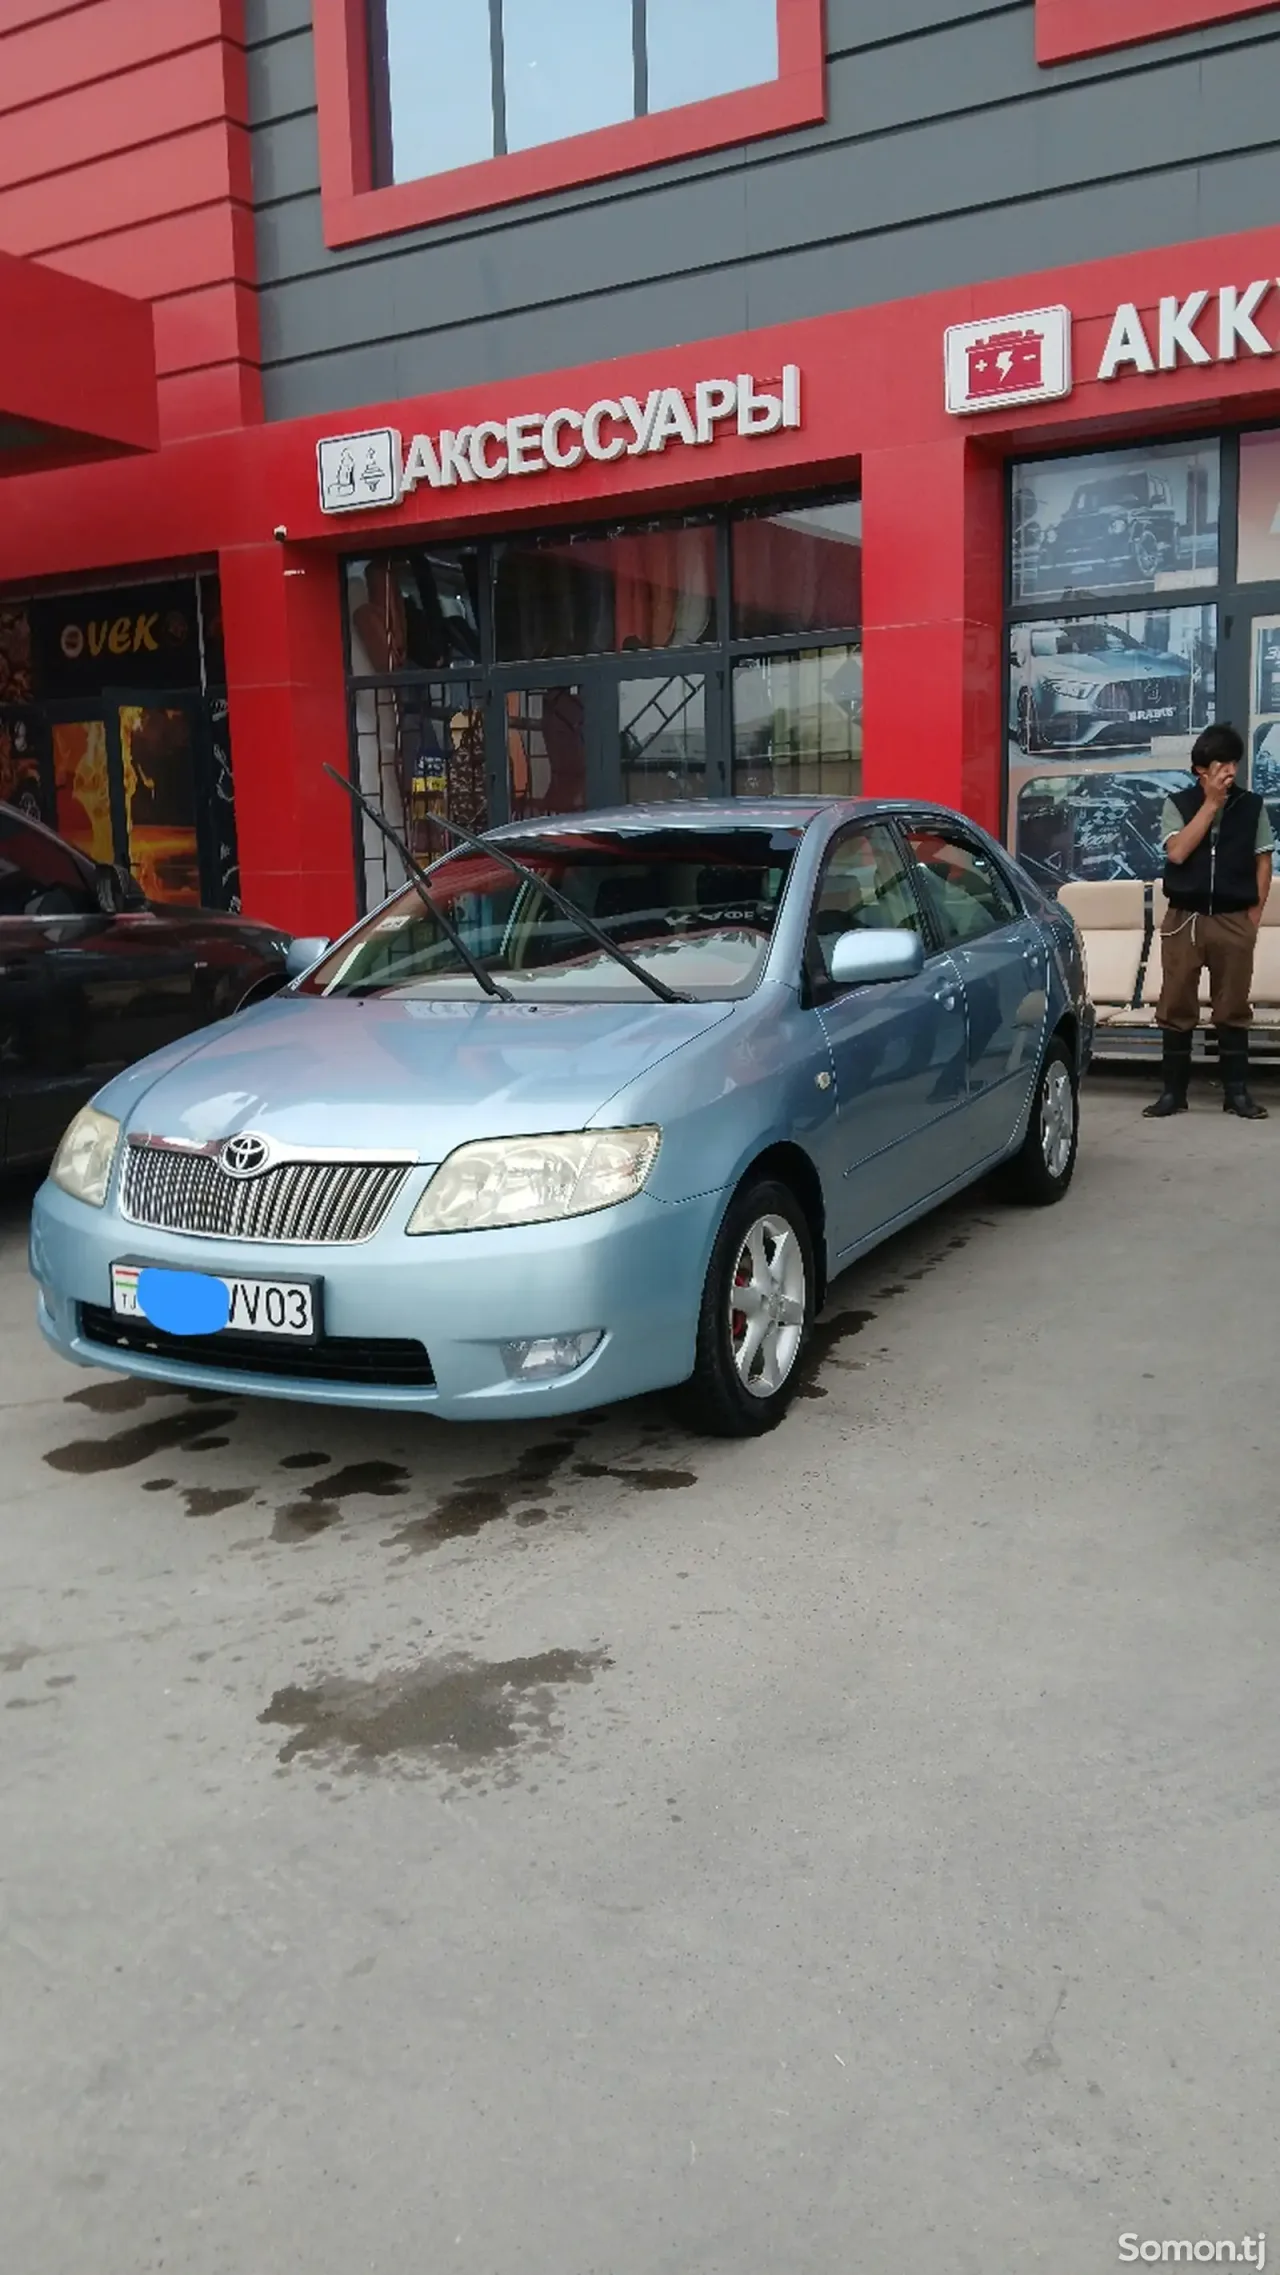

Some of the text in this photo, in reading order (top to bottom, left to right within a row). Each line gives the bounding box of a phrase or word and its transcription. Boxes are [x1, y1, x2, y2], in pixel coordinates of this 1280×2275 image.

[1097, 277, 1280, 380] АКК
[400, 365, 800, 492] АКСЕССУАРЫ
[121, 1292, 137, 1310] TJ
